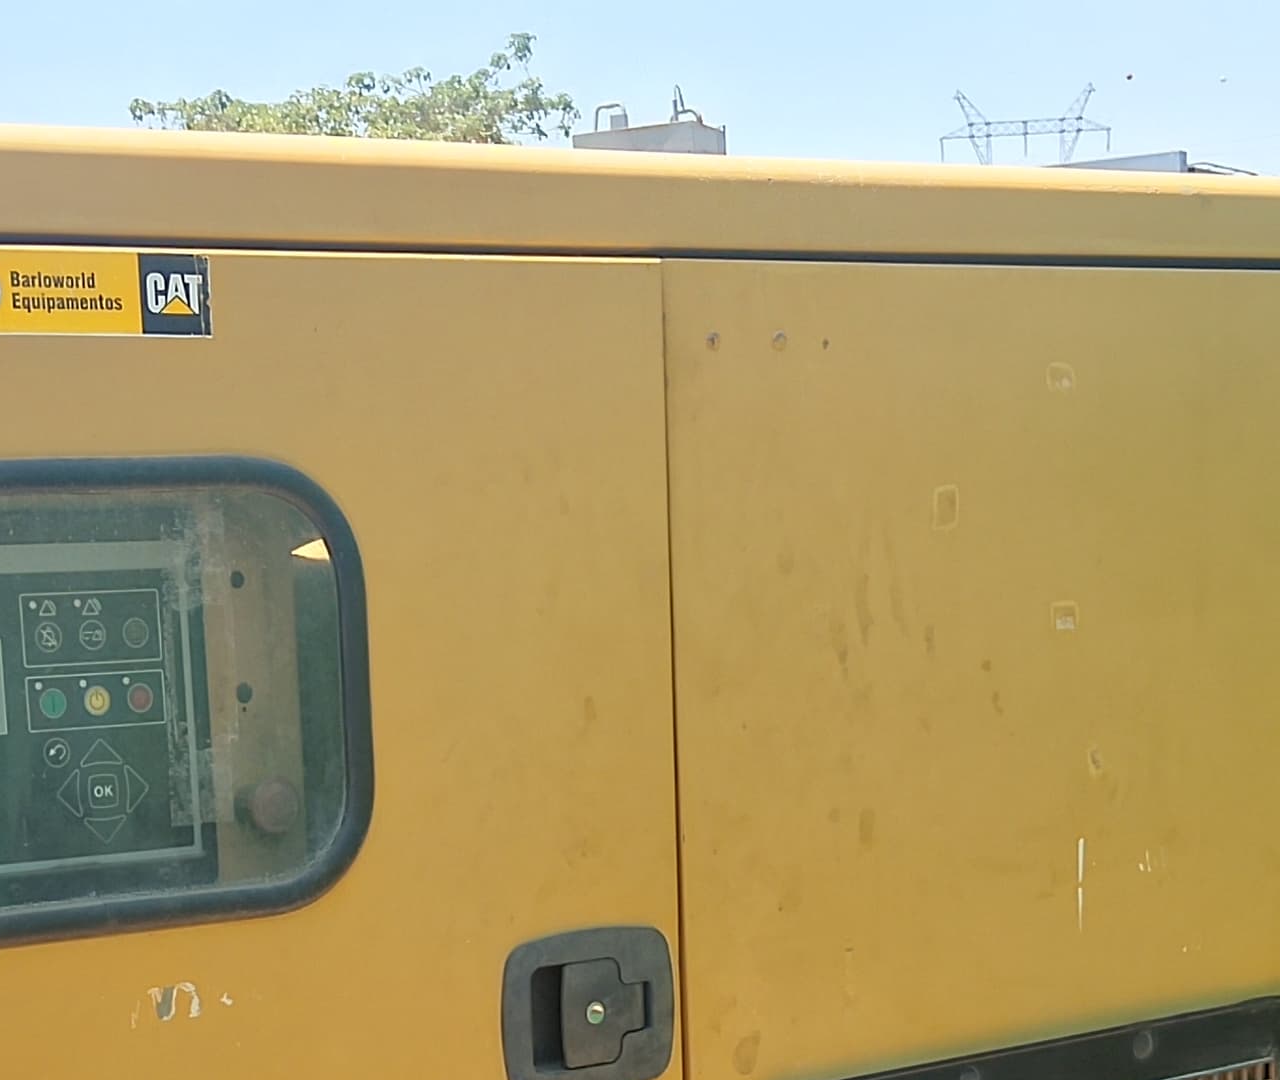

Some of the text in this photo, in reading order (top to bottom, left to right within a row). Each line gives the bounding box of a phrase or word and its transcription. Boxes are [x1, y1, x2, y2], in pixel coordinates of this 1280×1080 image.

[10, 270, 95, 289] Barloworld
[12, 292, 123, 313] Equipamentos
[146, 272, 203, 314] CAT
[93, 784, 113, 798] OK
